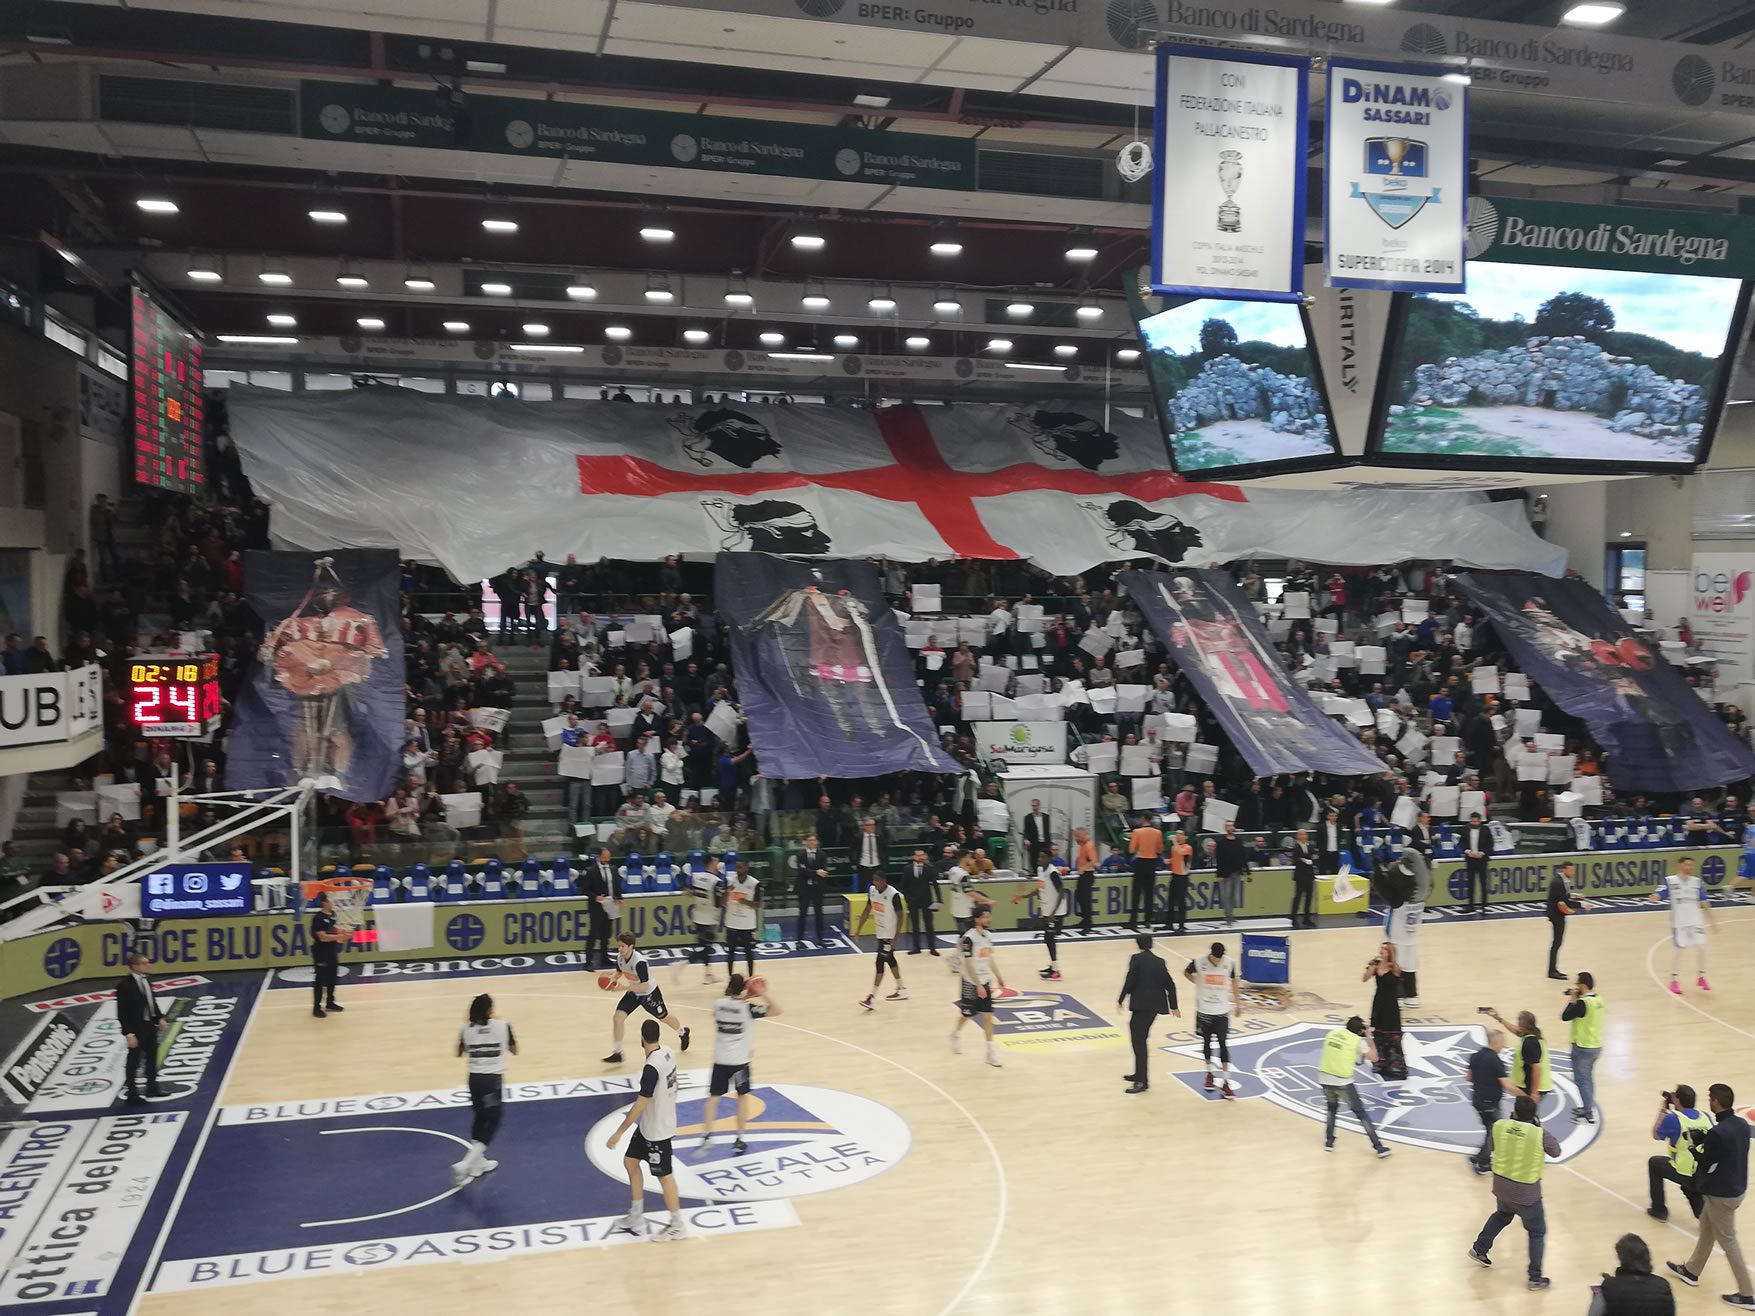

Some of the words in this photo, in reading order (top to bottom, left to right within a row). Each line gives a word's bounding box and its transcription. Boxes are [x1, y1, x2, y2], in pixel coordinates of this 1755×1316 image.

[857, 4, 910, 21] BPER:
[914, 11, 975, 30] Gruppo
[1167, 0, 1235, 29] Banco
[1240, 8, 1262, 31] di
[1264, 12, 1365, 43] Sardegna
[1455, 30, 1519, 59] Banco
[1520, 39, 1539, 62] di
[1542, 44, 1634, 74] Sardegna
[1221, 73, 1246, 89] CONI
[1499, 70, 1551, 88] Gruppo
[1721, 61, 1755, 85] Ban
[1180, 94, 1242, 114] FEDERAZIONE
[1243, 100, 1284, 117] ITALIANA
[1363, 108, 1430, 125] SASSARI
[1720, 93, 1755, 108] BPER
[1194, 122, 1269, 142] PALLACANESTRO
[1501, 216, 1584, 251] Banco
[1585, 223, 1612, 253] di
[1612, 224, 1729, 265] Sardegna
[1338, 254, 1420, 273] SUPERCOPPA
[133, 686, 196, 721] 24
[1487, 864, 1547, 895] CROCE
[1590, 860, 1667, 890] SASSARI
[207, 926, 262, 961] BLU
[504, 910, 590, 944] CROCE
[358, 956, 536, 977] Banco
[11, 1023, 77, 1090] Panasonic
[246, 1098, 357, 1120] BLUE
[413, 1073, 692, 1108] ASISTANE
[66, 1115, 149, 1195] delogu
[695, 1142, 870, 1185] REALE
[714, 1156, 887, 1196] MUTUA
[17, 1206, 99, 1300] ottica
[190, 1248, 334, 1282] BLUE
